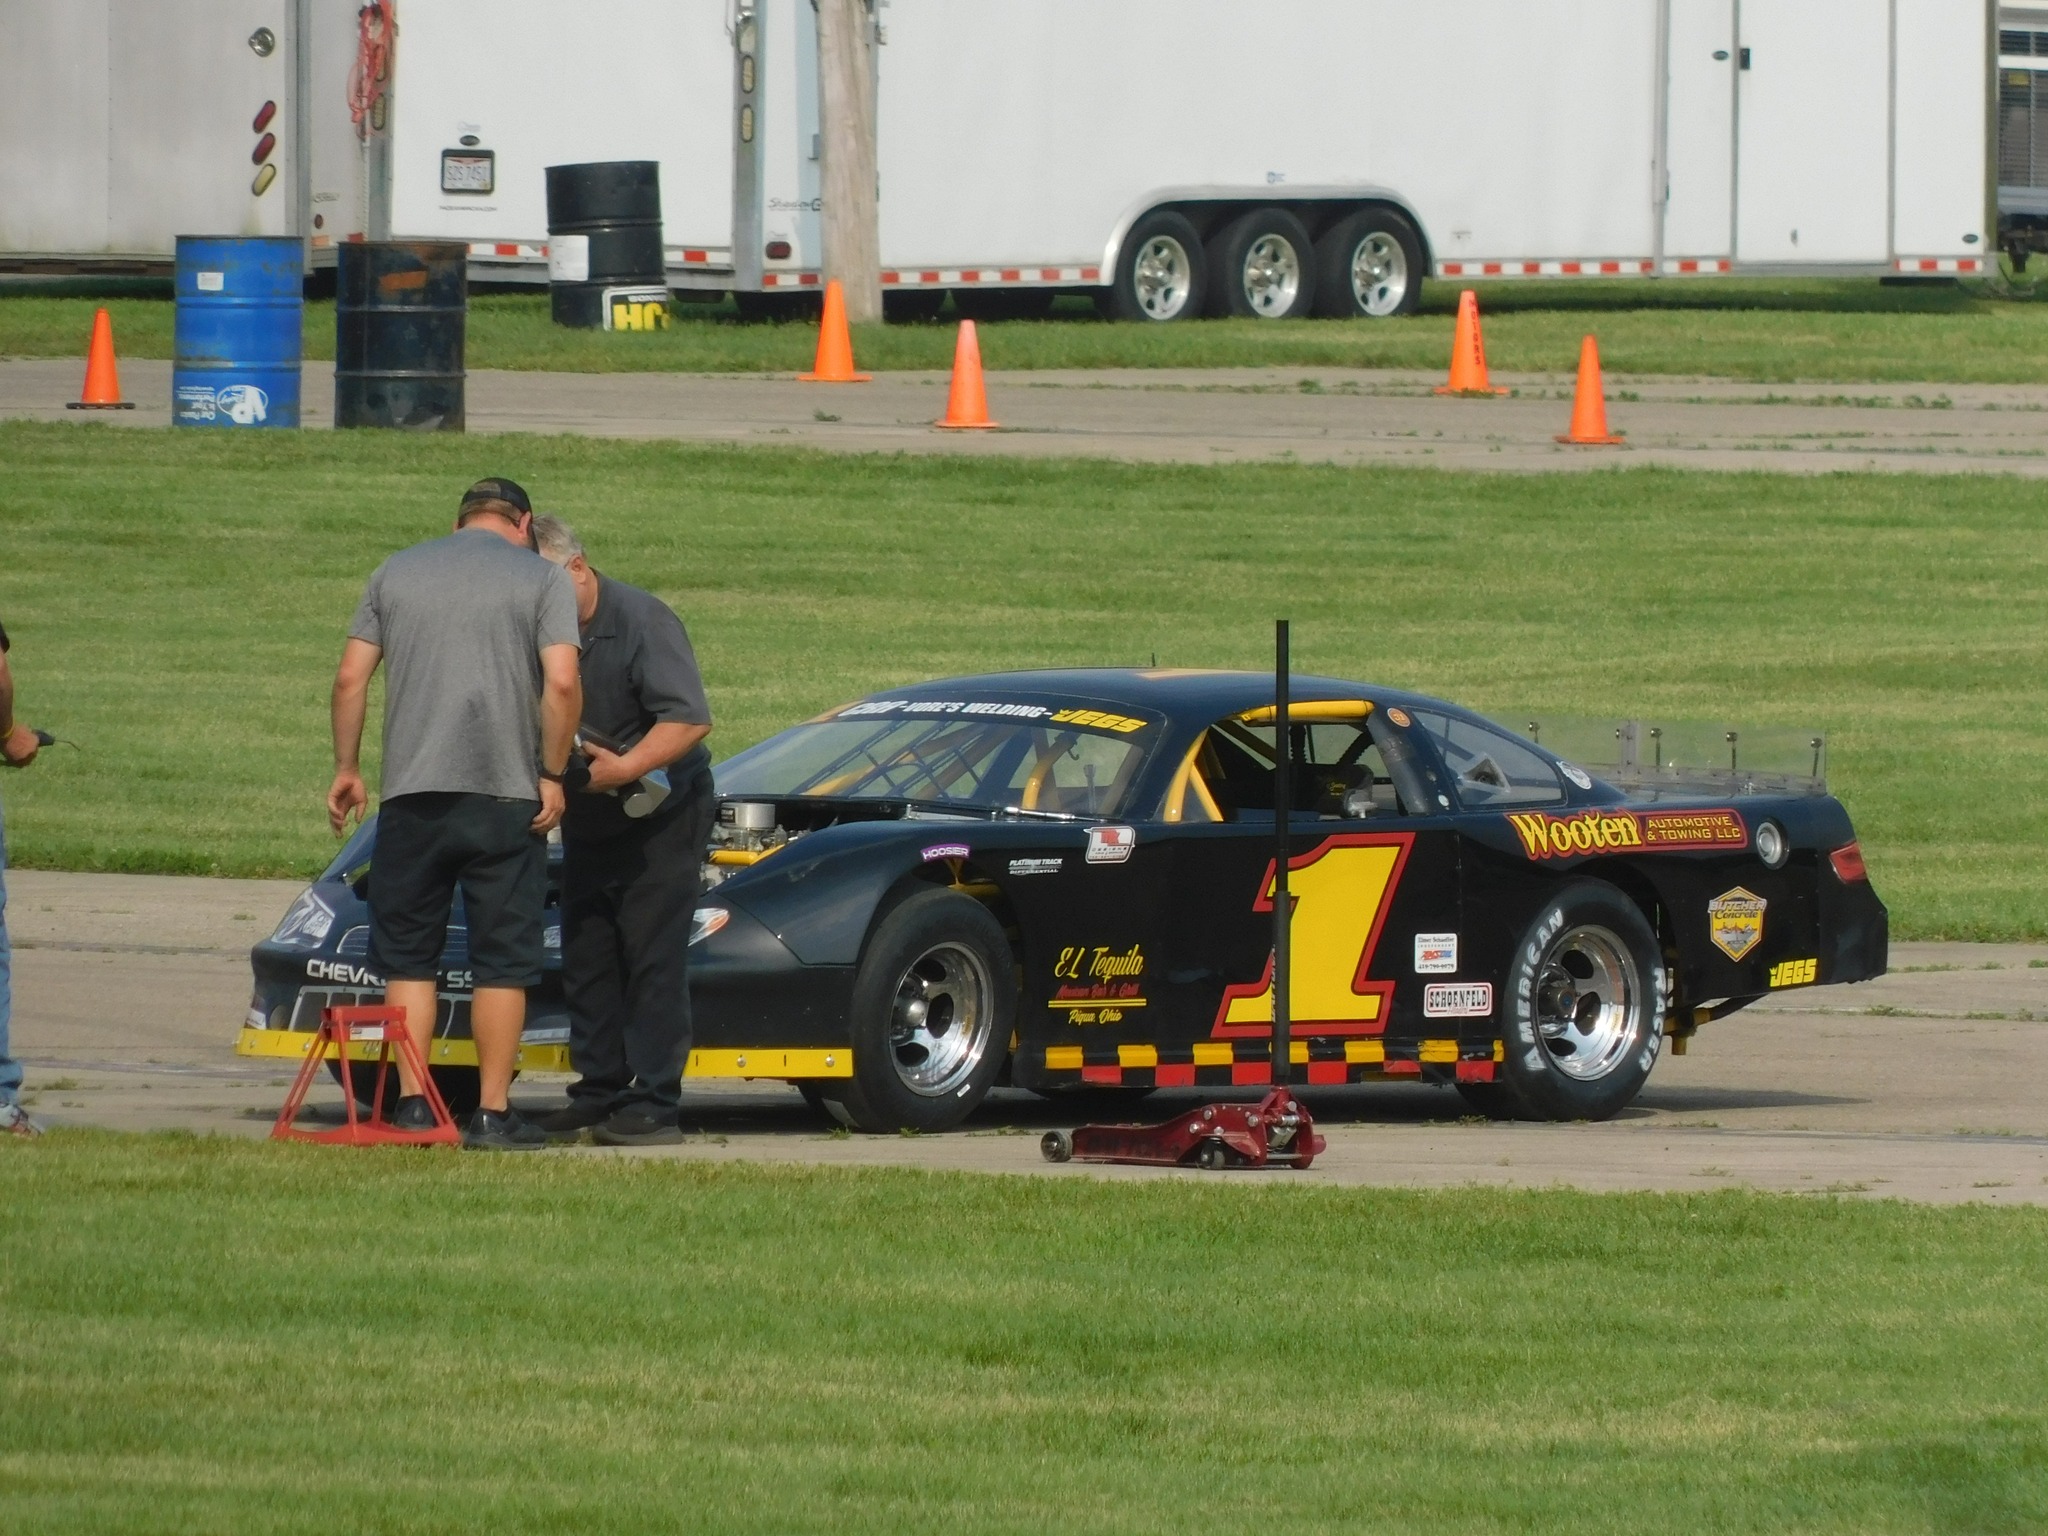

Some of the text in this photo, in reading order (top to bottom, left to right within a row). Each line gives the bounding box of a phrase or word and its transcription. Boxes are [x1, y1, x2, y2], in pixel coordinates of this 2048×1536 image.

[1510, 812, 1642, 854] Wooten
[1647, 827, 1741, 841] & TOWING LLC
[1648, 816, 1733, 829] AUTOMOTIVE
[922, 846, 970, 860] HOOSIER
[1715, 910, 1759, 919] Concrete
[1089, 943, 1144, 985] Tequila
[1769, 958, 1818, 988] JEGS
[1429, 990, 1487, 1008] SCHOENFELD
[1517, 908, 1564, 1071] AMERICAN
[1638, 967, 1667, 1073] RACER
